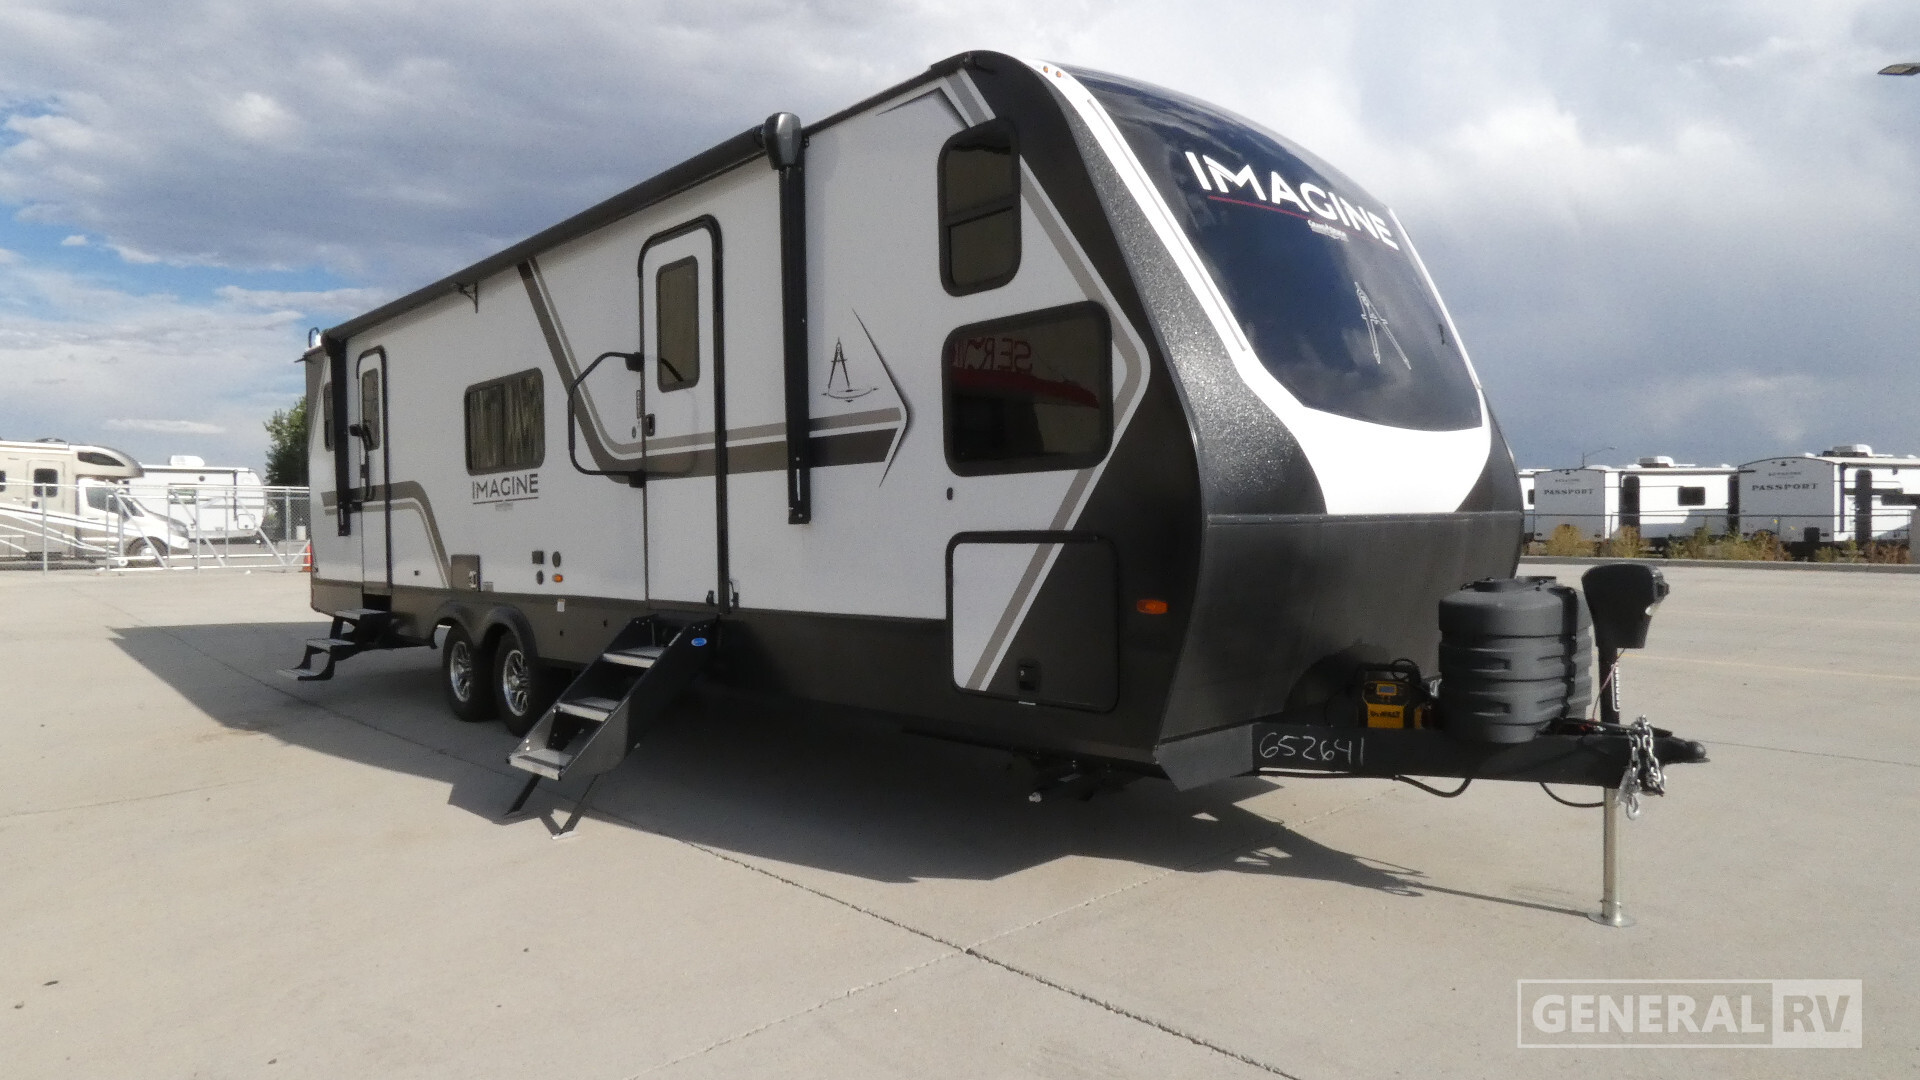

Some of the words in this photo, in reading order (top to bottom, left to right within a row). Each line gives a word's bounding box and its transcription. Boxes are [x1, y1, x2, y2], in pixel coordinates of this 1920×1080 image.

[1185, 151, 1399, 250] IMAGINE
[472, 473, 539, 499] IMAGINE
[1752, 482, 1819, 491] PASSPORT
[1259, 732, 1365, 766] 652641
